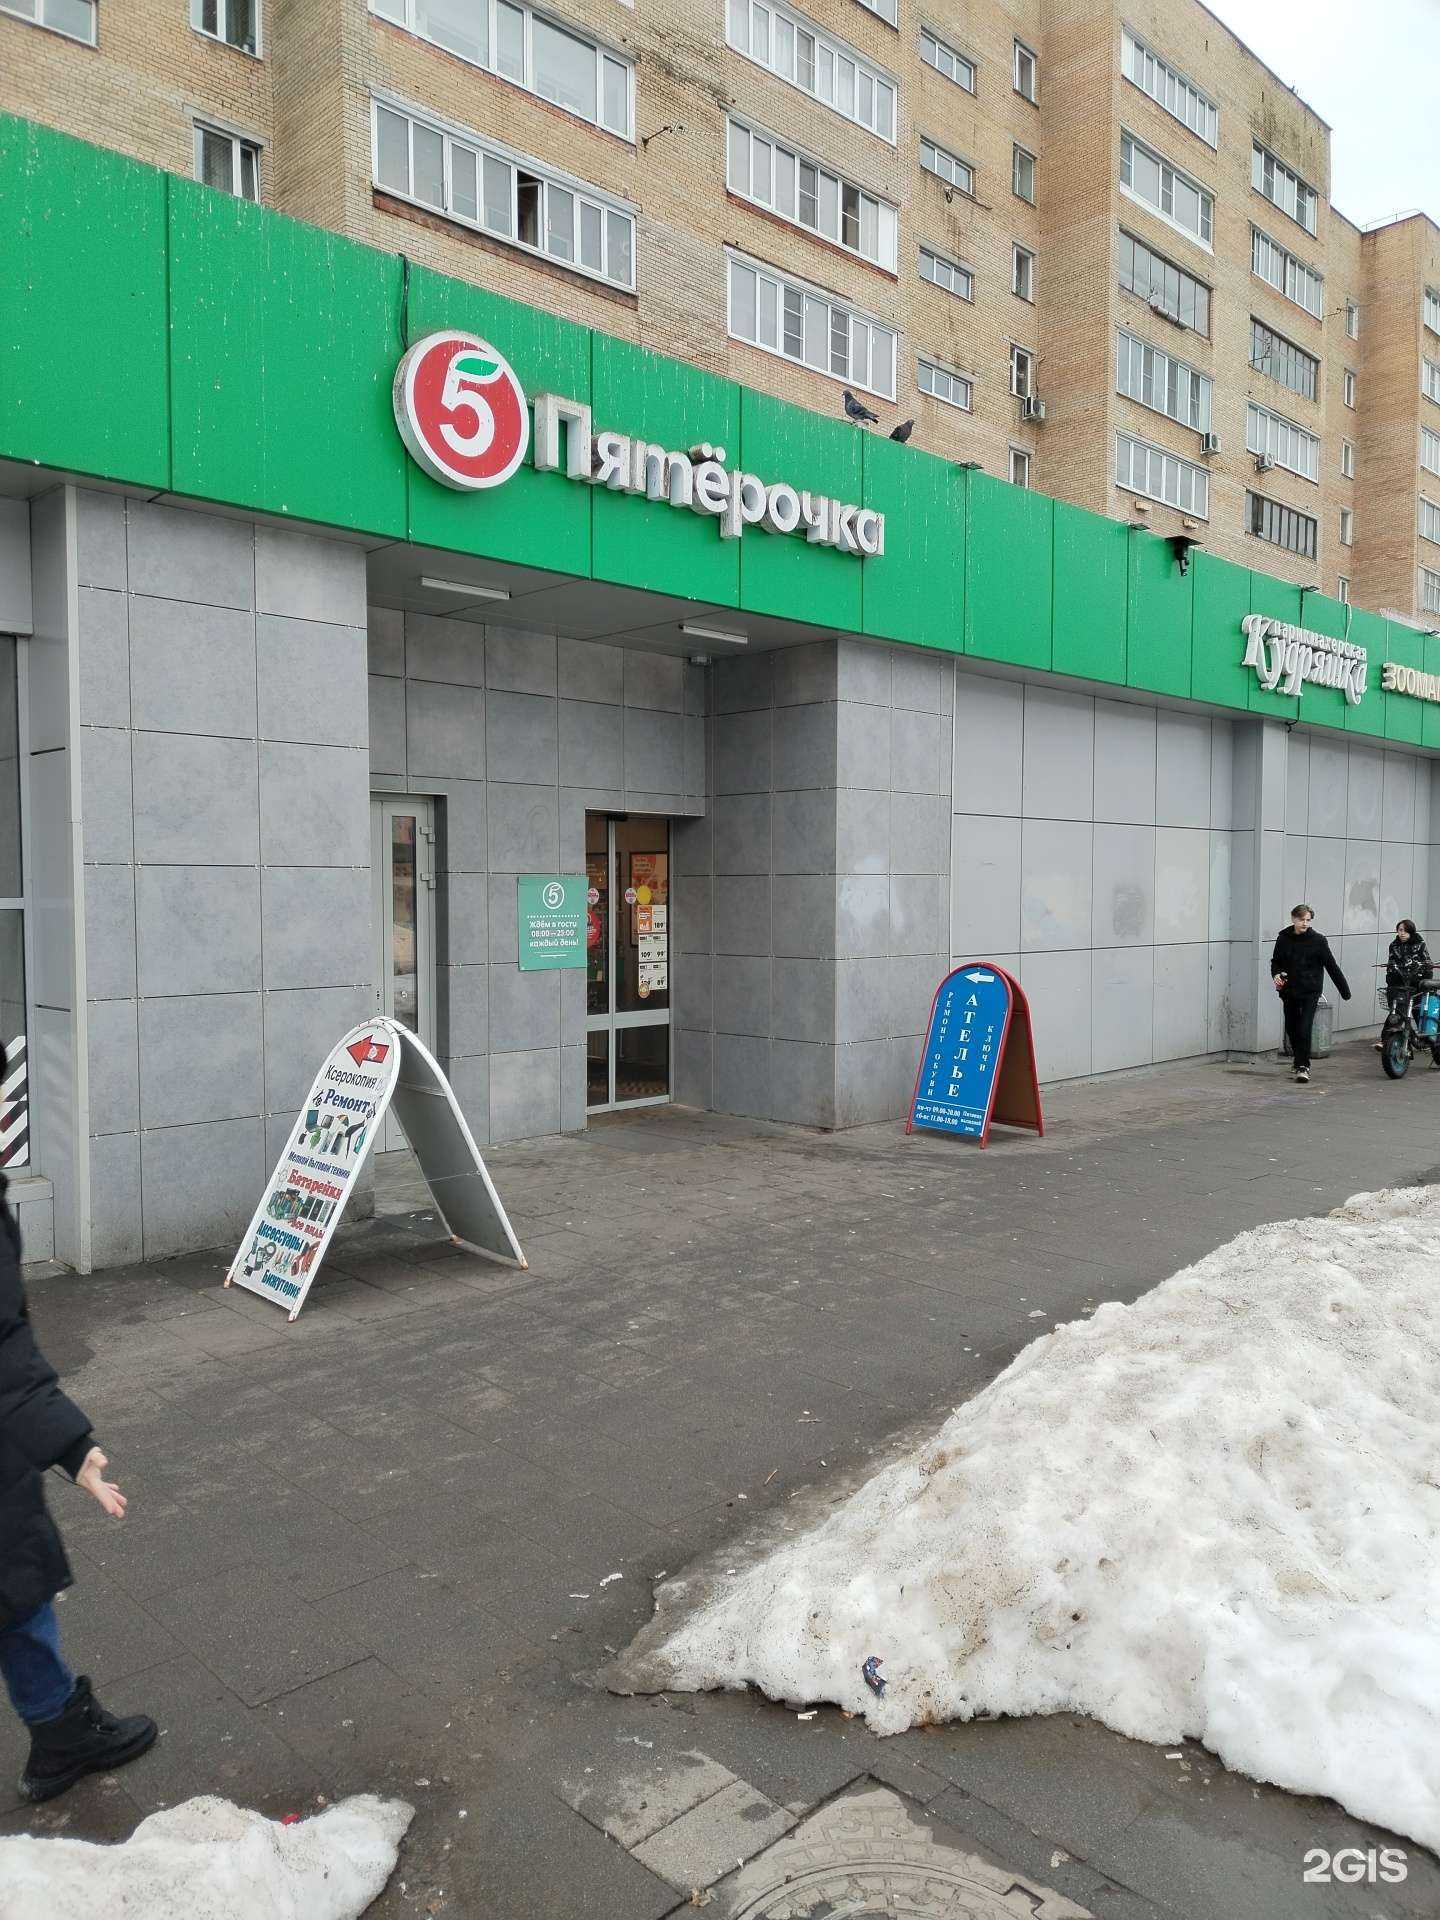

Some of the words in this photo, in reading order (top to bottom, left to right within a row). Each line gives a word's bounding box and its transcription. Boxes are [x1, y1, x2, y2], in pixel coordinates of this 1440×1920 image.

[533, 392, 885, 558] Пятёрочка
[1382, 662, 1440, 703] ЗООМА
[557, 920, 577, 928] гости
[529, 939, 558, 948] каждый
[559, 938, 579, 947] день!
[938, 991, 954, 1043] РЕМОНТ
[946, 992, 978, 1098] АТЕЛЬЕ
[979, 1025, 994, 1072] КЛЮЧИ
[324, 1064, 378, 1090] Ксерокопия
[323, 1088, 371, 1114] Ремонт
[287, 1168, 343, 1201] Батарейки
[256, 1219, 304, 1253] Аксессуары
